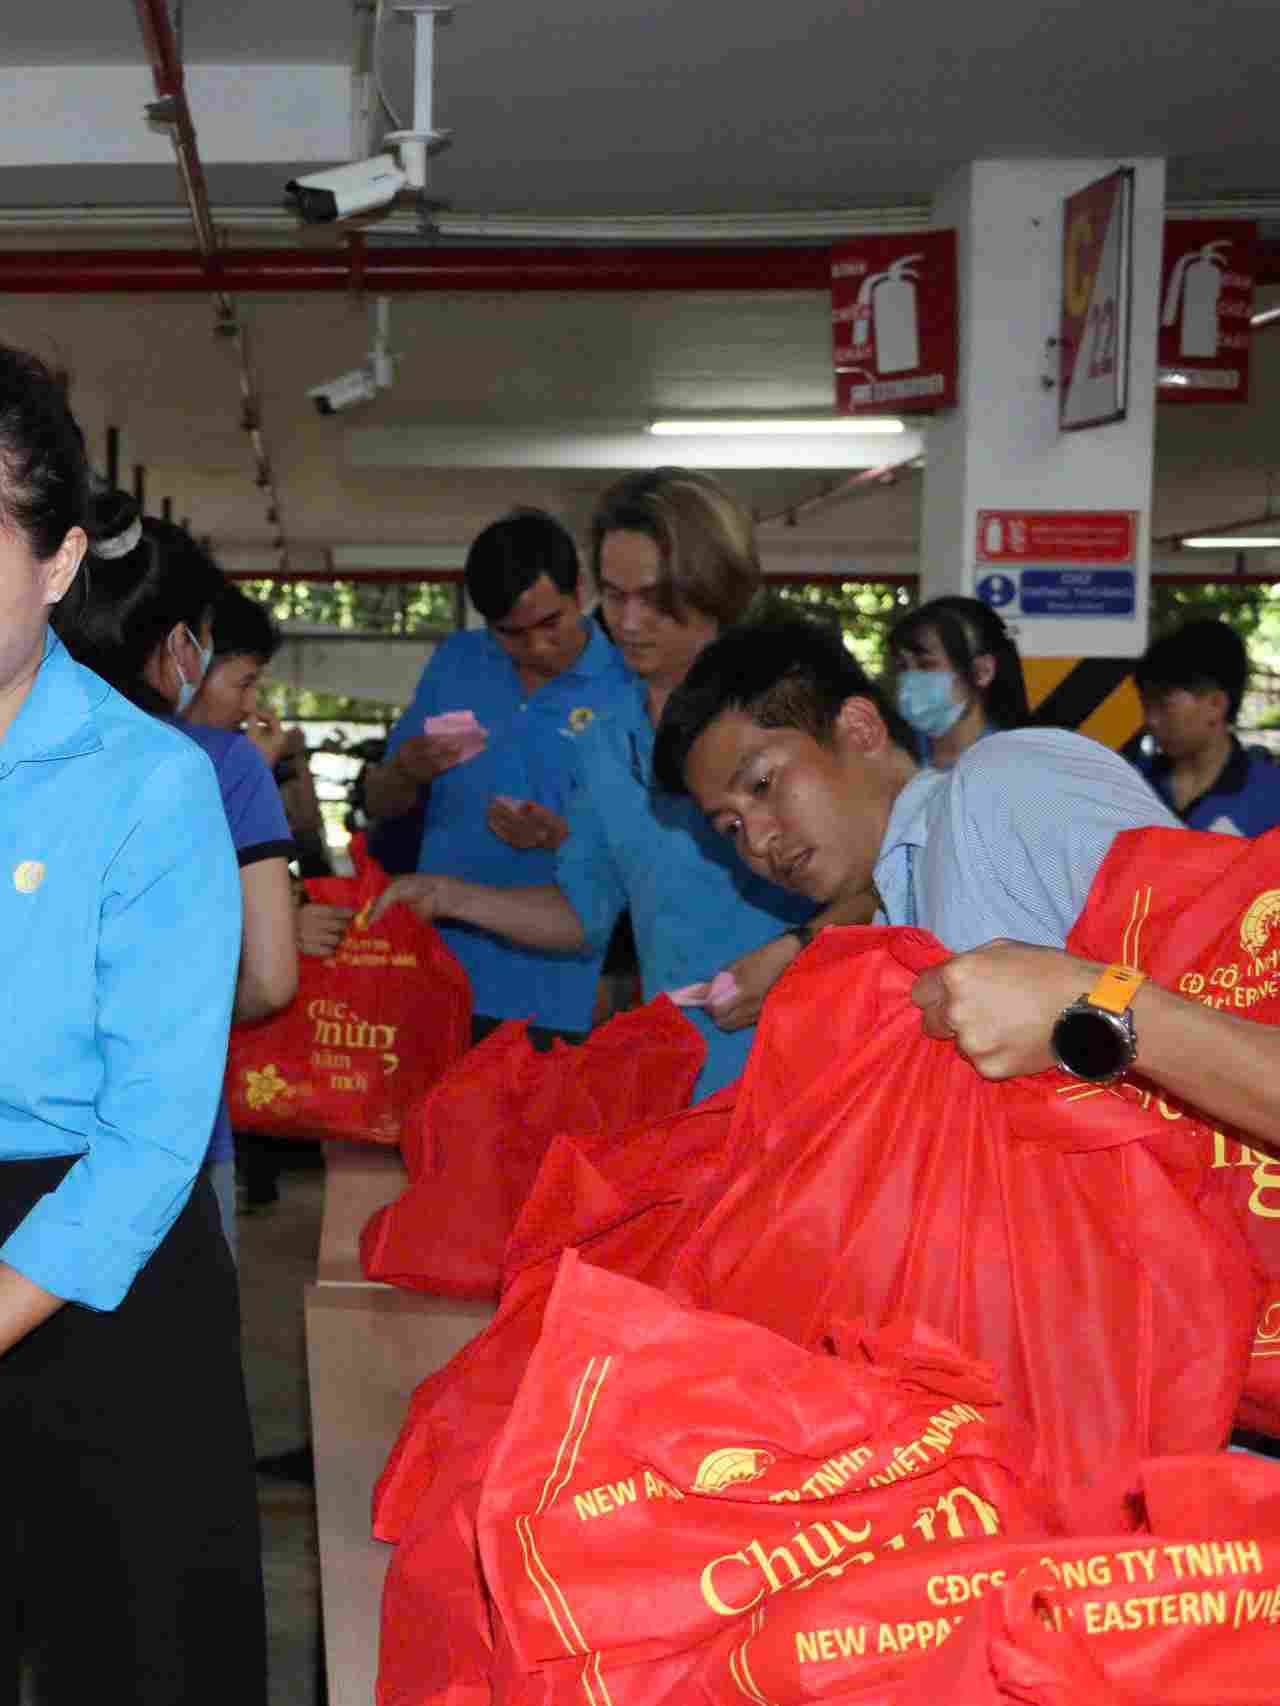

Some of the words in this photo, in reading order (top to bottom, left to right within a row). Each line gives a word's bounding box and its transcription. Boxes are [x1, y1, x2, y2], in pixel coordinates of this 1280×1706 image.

[573, 1477, 638, 1521] NEW
[1116, 1548, 1157, 1584] TY
[1164, 1540, 1264, 1580] TNHH
[795, 1624, 866, 1664] NEW
[1084, 1591, 1227, 1635] EASTERN
